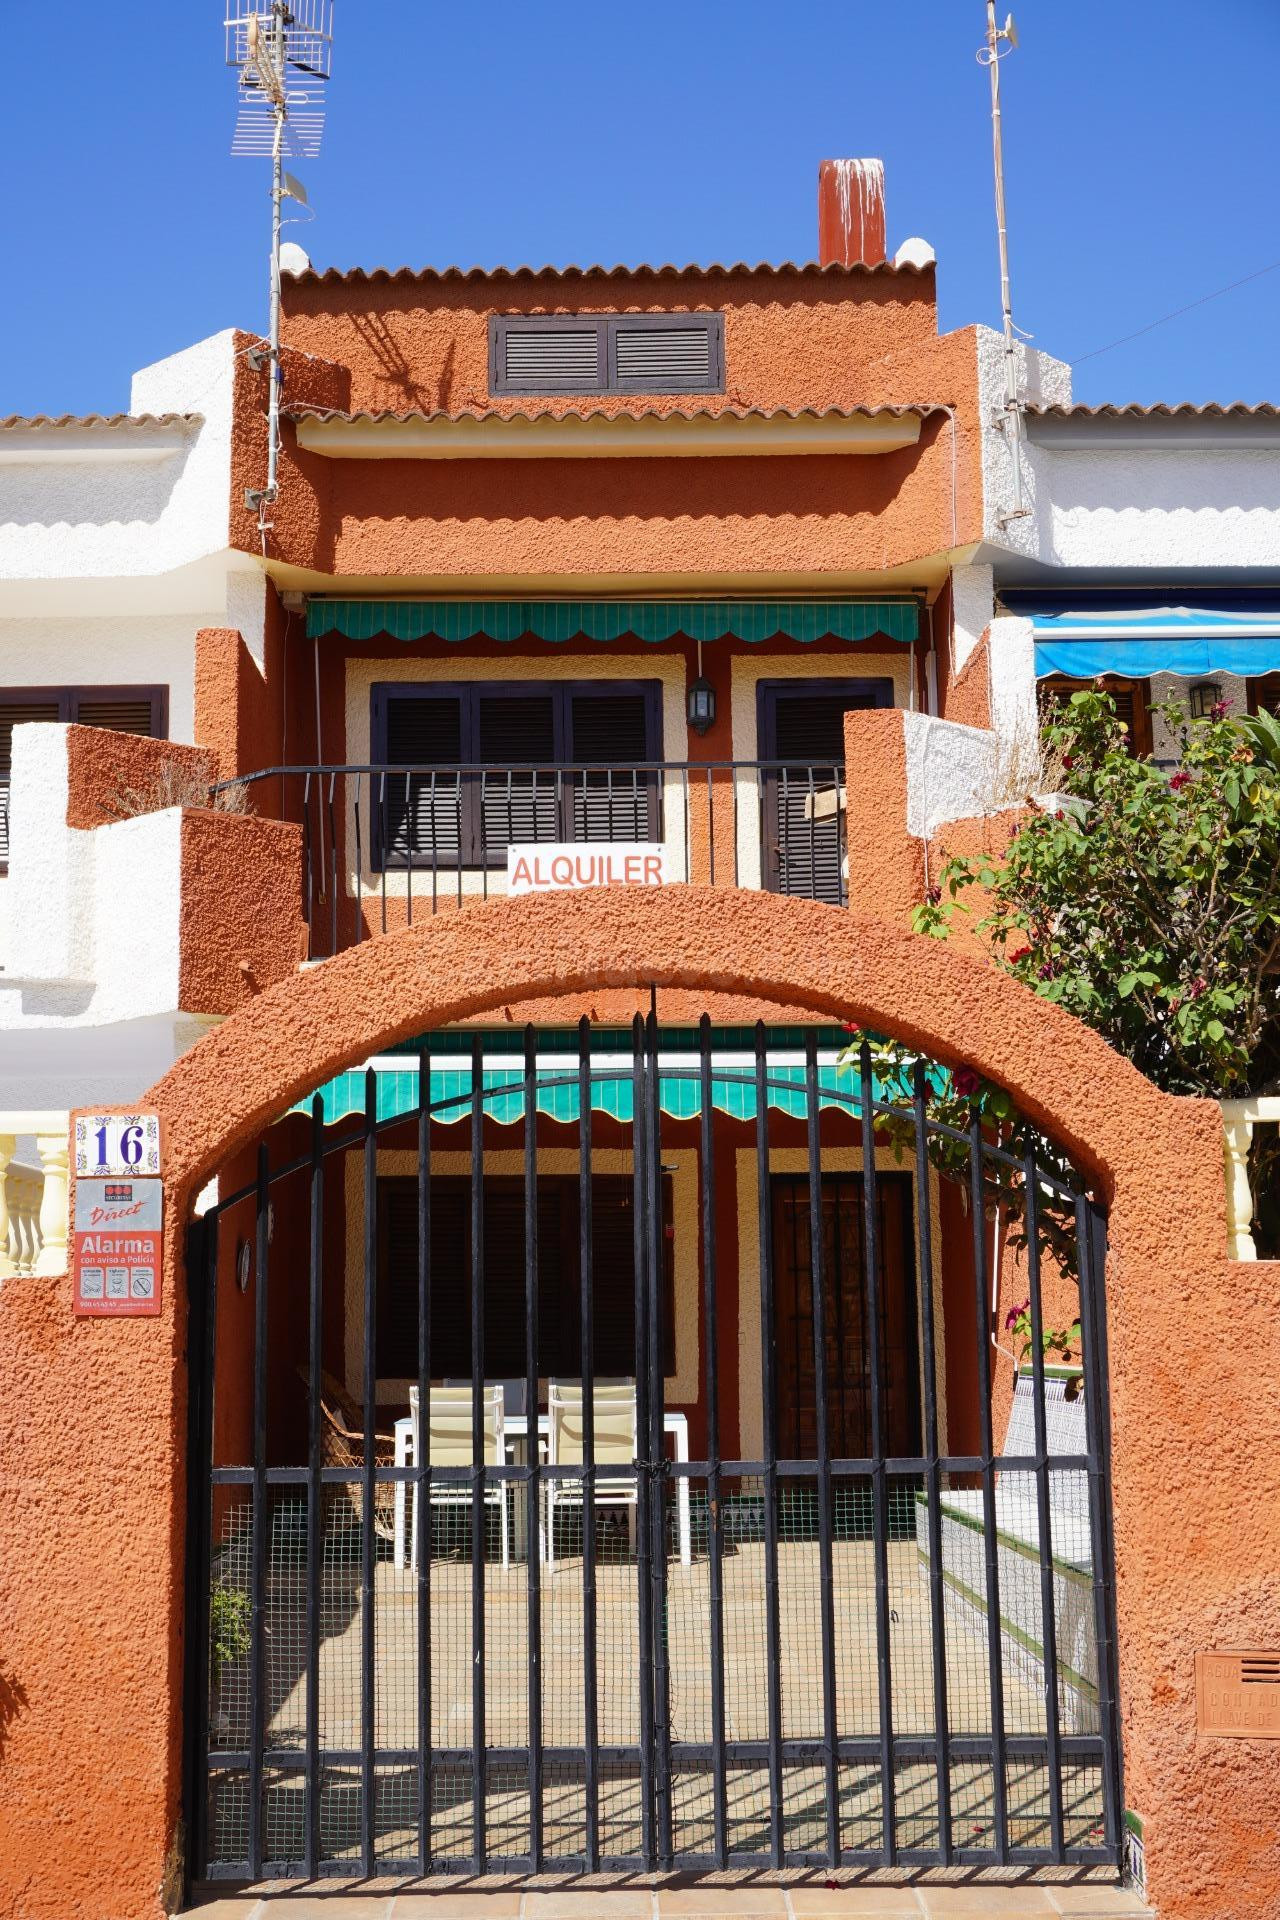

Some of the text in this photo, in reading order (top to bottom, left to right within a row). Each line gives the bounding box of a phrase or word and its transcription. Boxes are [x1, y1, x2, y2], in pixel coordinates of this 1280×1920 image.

[512, 855, 663, 886] ALQUILER
[95, 1126, 144, 1166] 16
[90, 1200, 149, 1226] Direct
[80, 1235, 154, 1254] Alarma
[80, 1256, 95, 1264] con
[97, 1256, 119, 1264] aviso
[1206, 1664, 1239, 1679] AGUA
[1257, 1711, 1273, 1726] DE
